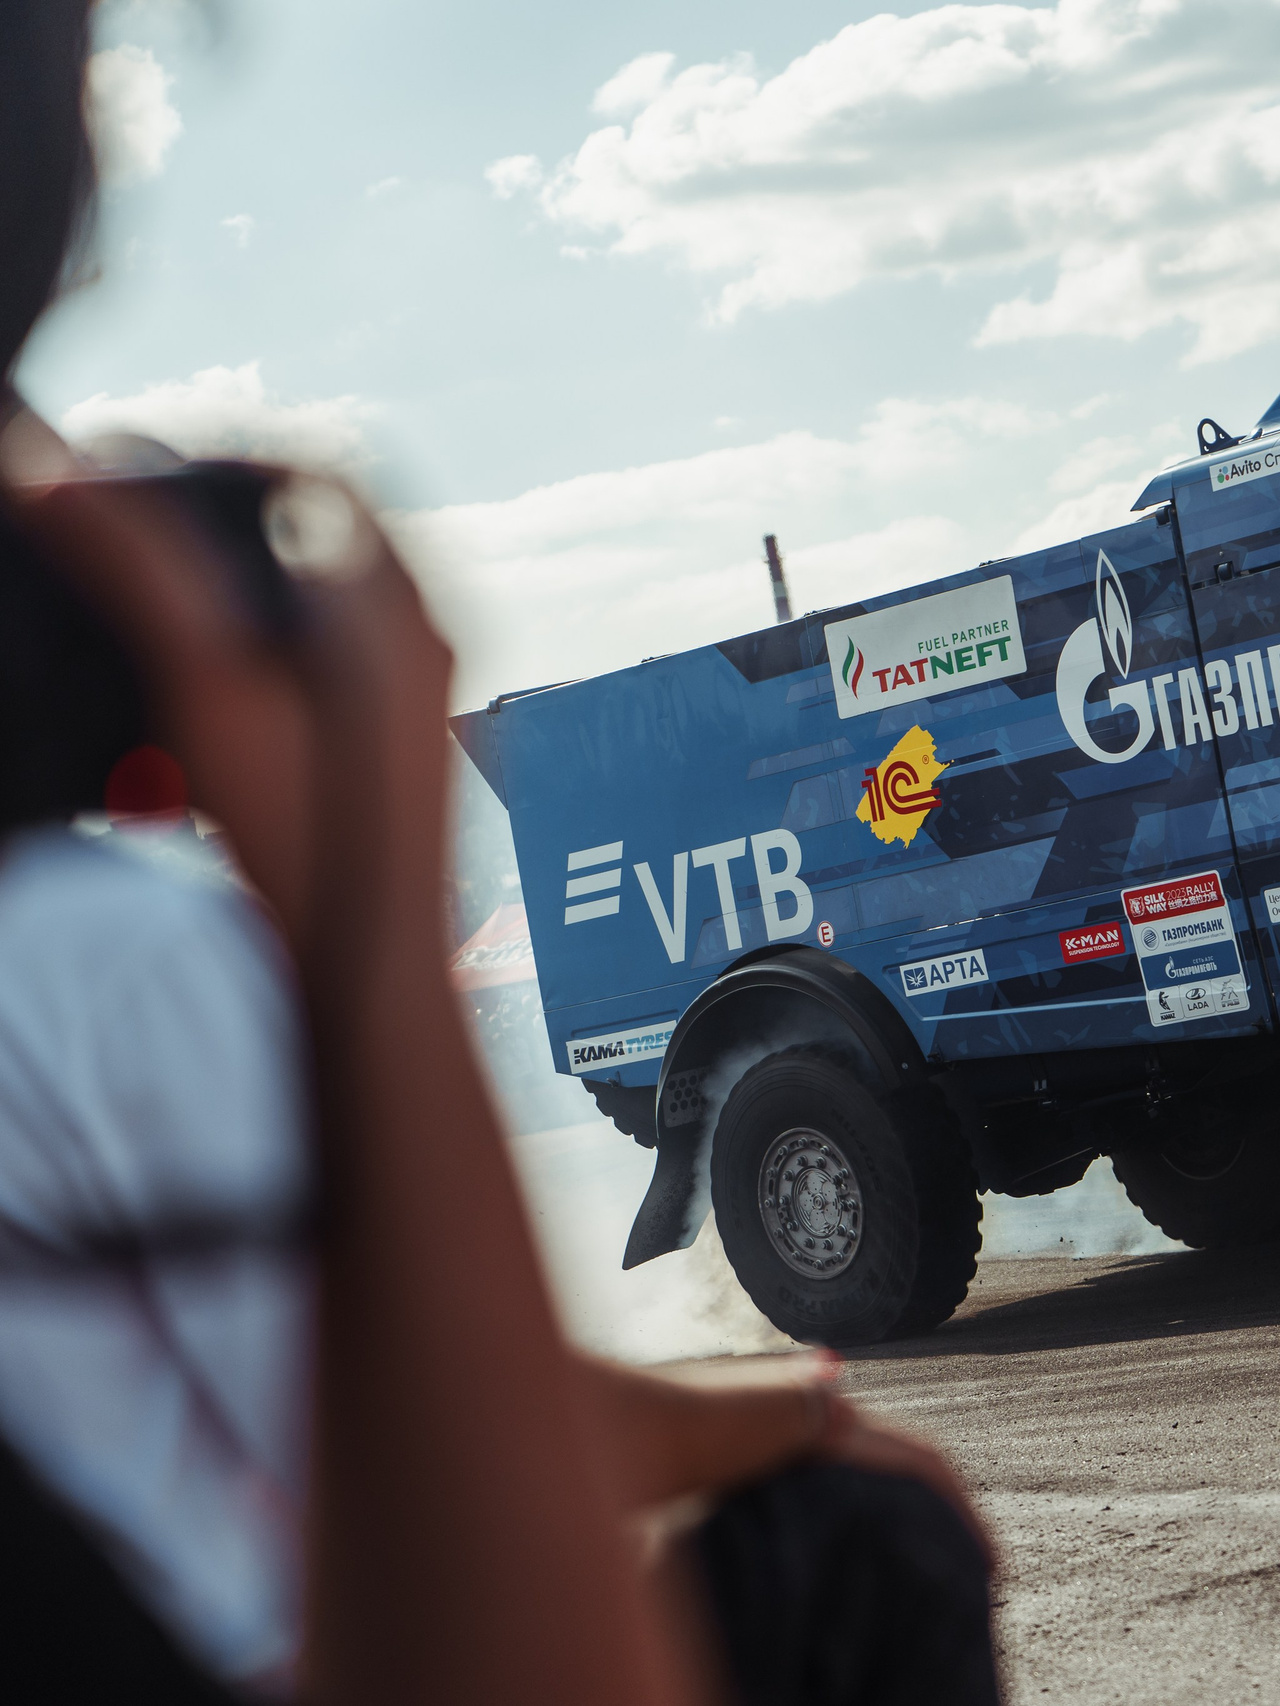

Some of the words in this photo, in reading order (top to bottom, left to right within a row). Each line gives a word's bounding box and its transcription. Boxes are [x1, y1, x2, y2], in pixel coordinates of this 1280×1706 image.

[1230, 458, 1262, 480] Avito
[918, 636, 949, 654] FUEL
[952, 619, 1009, 645] PARTNER
[872, 636, 1012, 693] TATNEFT
[632, 828, 815, 964] VTB
[1144, 892, 1166, 905] SILK
[1165, 887, 1186, 900] 2023
[1186, 881, 1215, 896] RALLY
[1145, 902, 1168, 914] WAY
[820, 926, 831, 943] E
[1162, 918, 1225, 941] ГАЗПРОМБАНК
[1068, 947, 1093, 956] SUSPENSION
[1093, 942, 1120, 951] TECHNOLOGY
[1187, 1001, 1209, 1011] LADA
